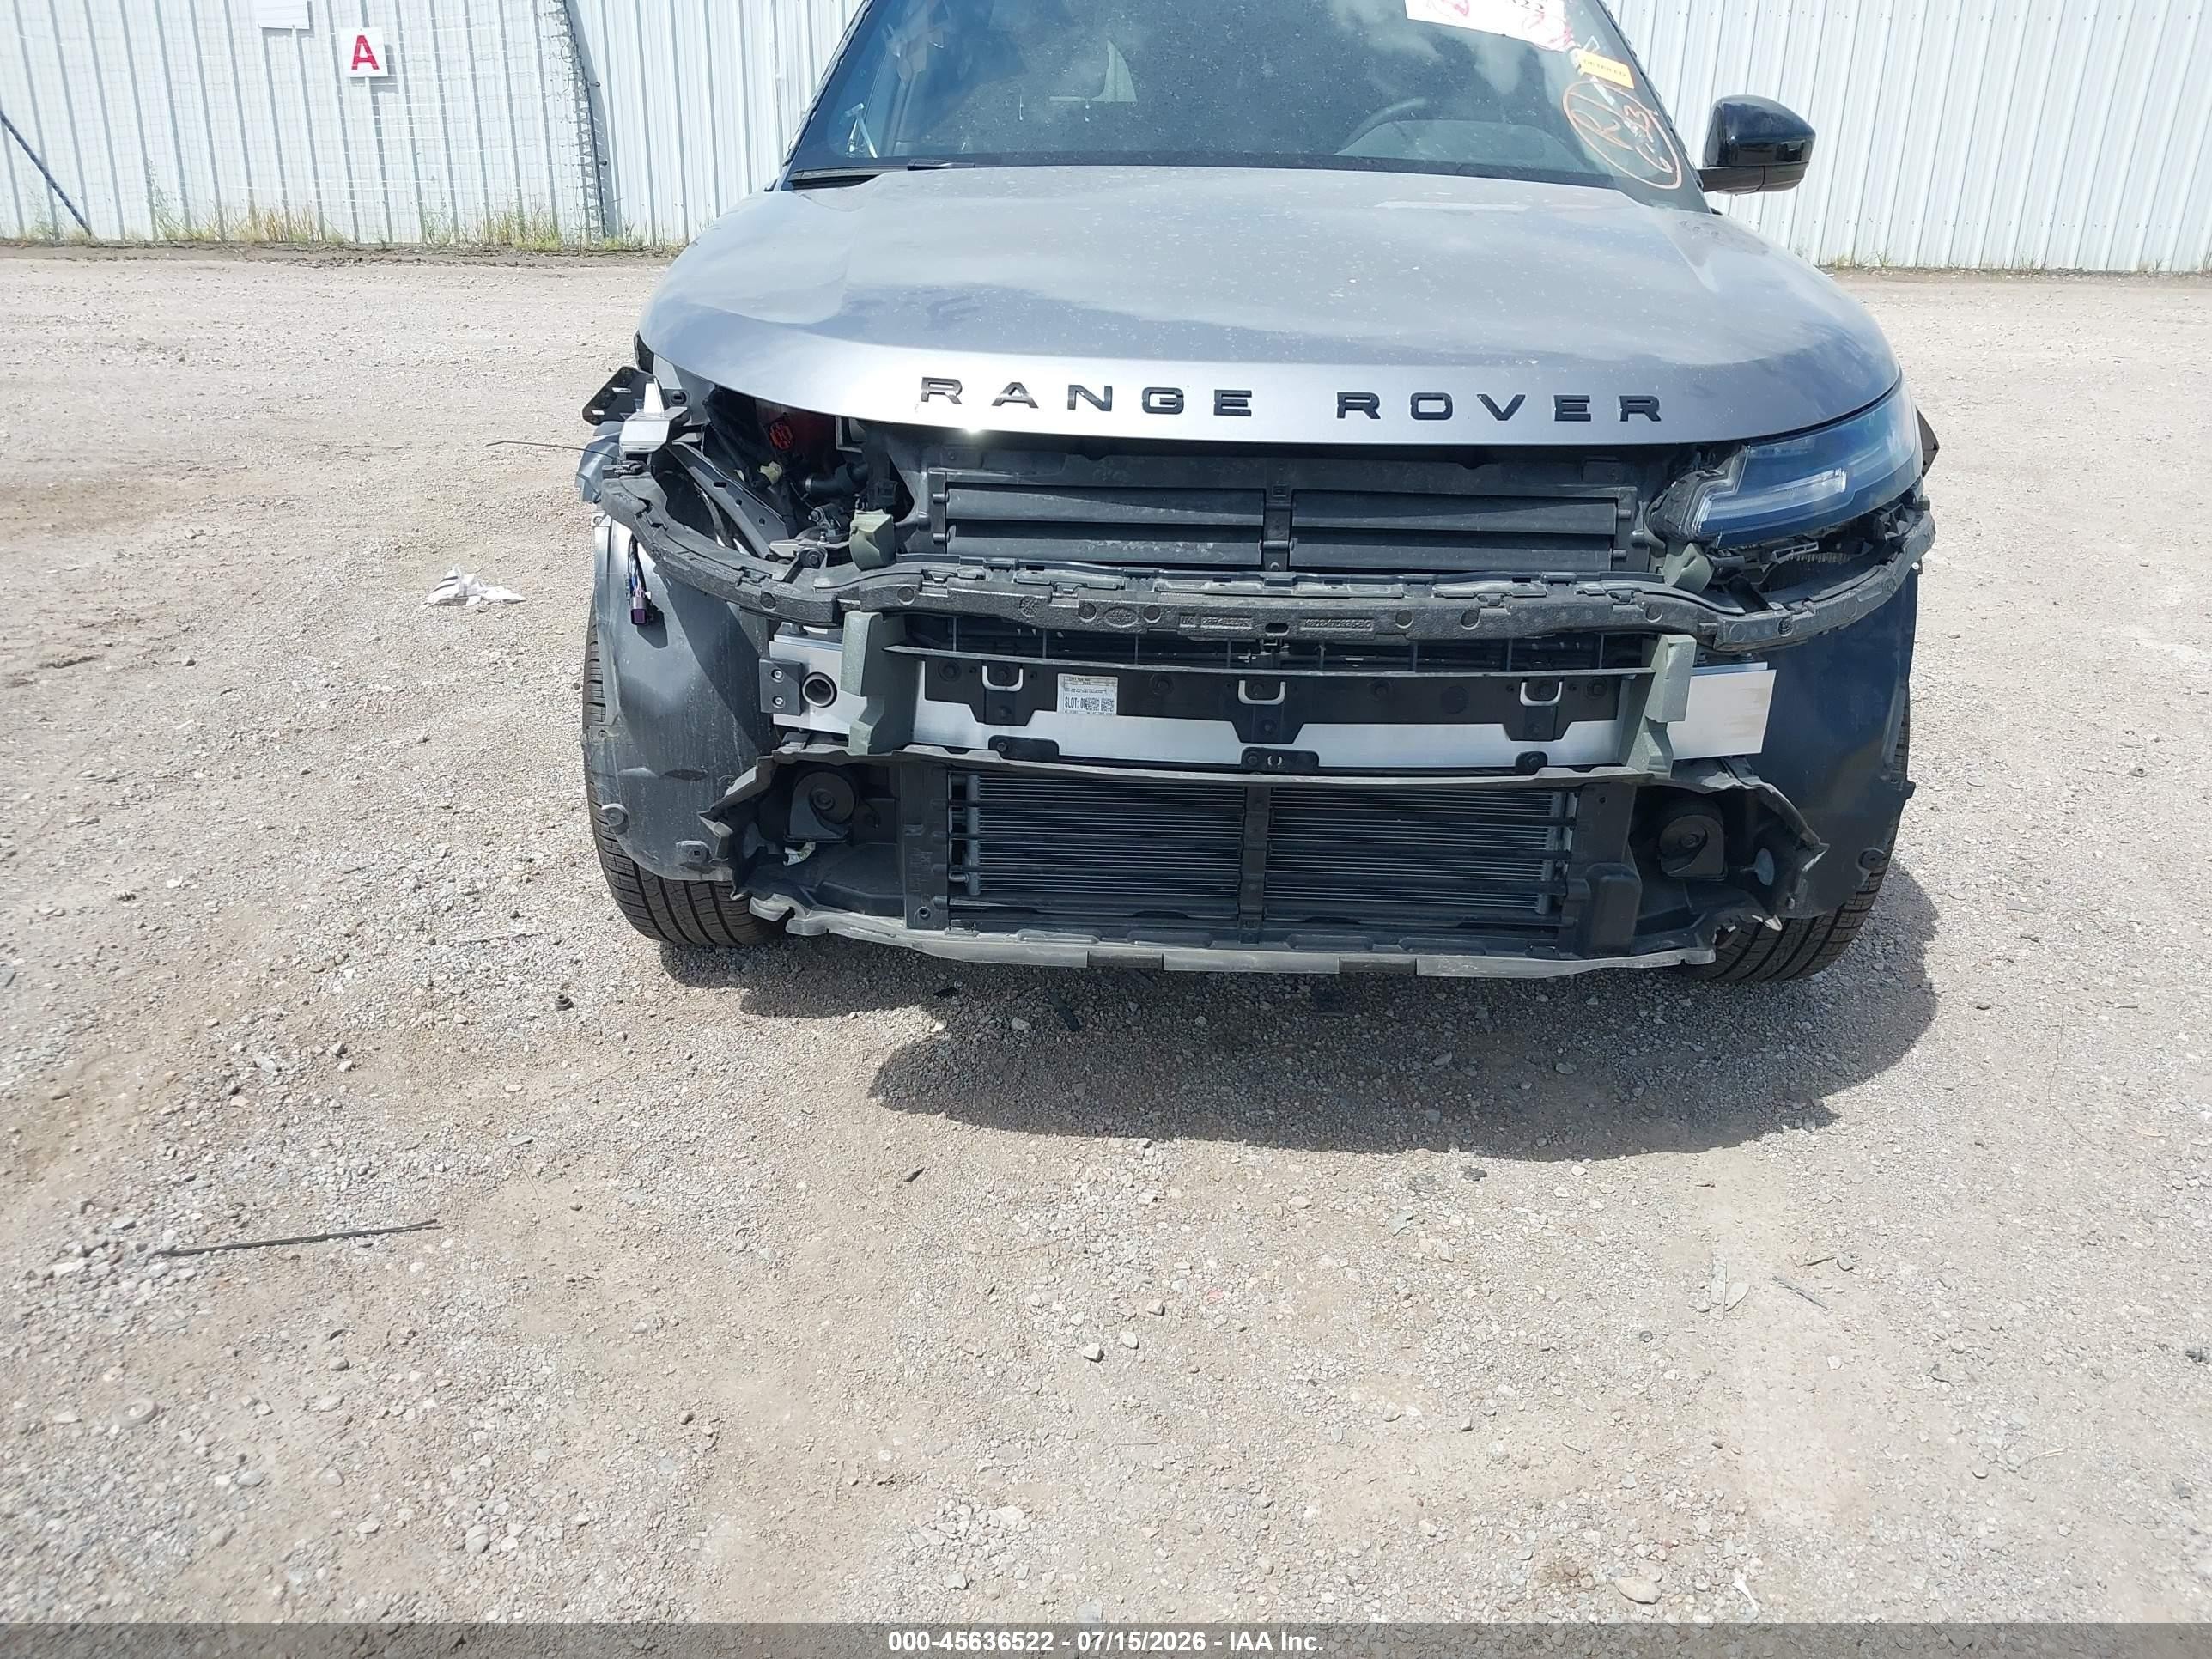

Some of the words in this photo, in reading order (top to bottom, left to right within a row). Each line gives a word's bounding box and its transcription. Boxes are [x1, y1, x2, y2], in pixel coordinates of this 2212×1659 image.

[351, 35, 380, 70] A
[921, 376, 1252, 417] RANGE
[1337, 392, 1661, 422] ROVER
[1065, 696, 1079, 709] SLOT:
